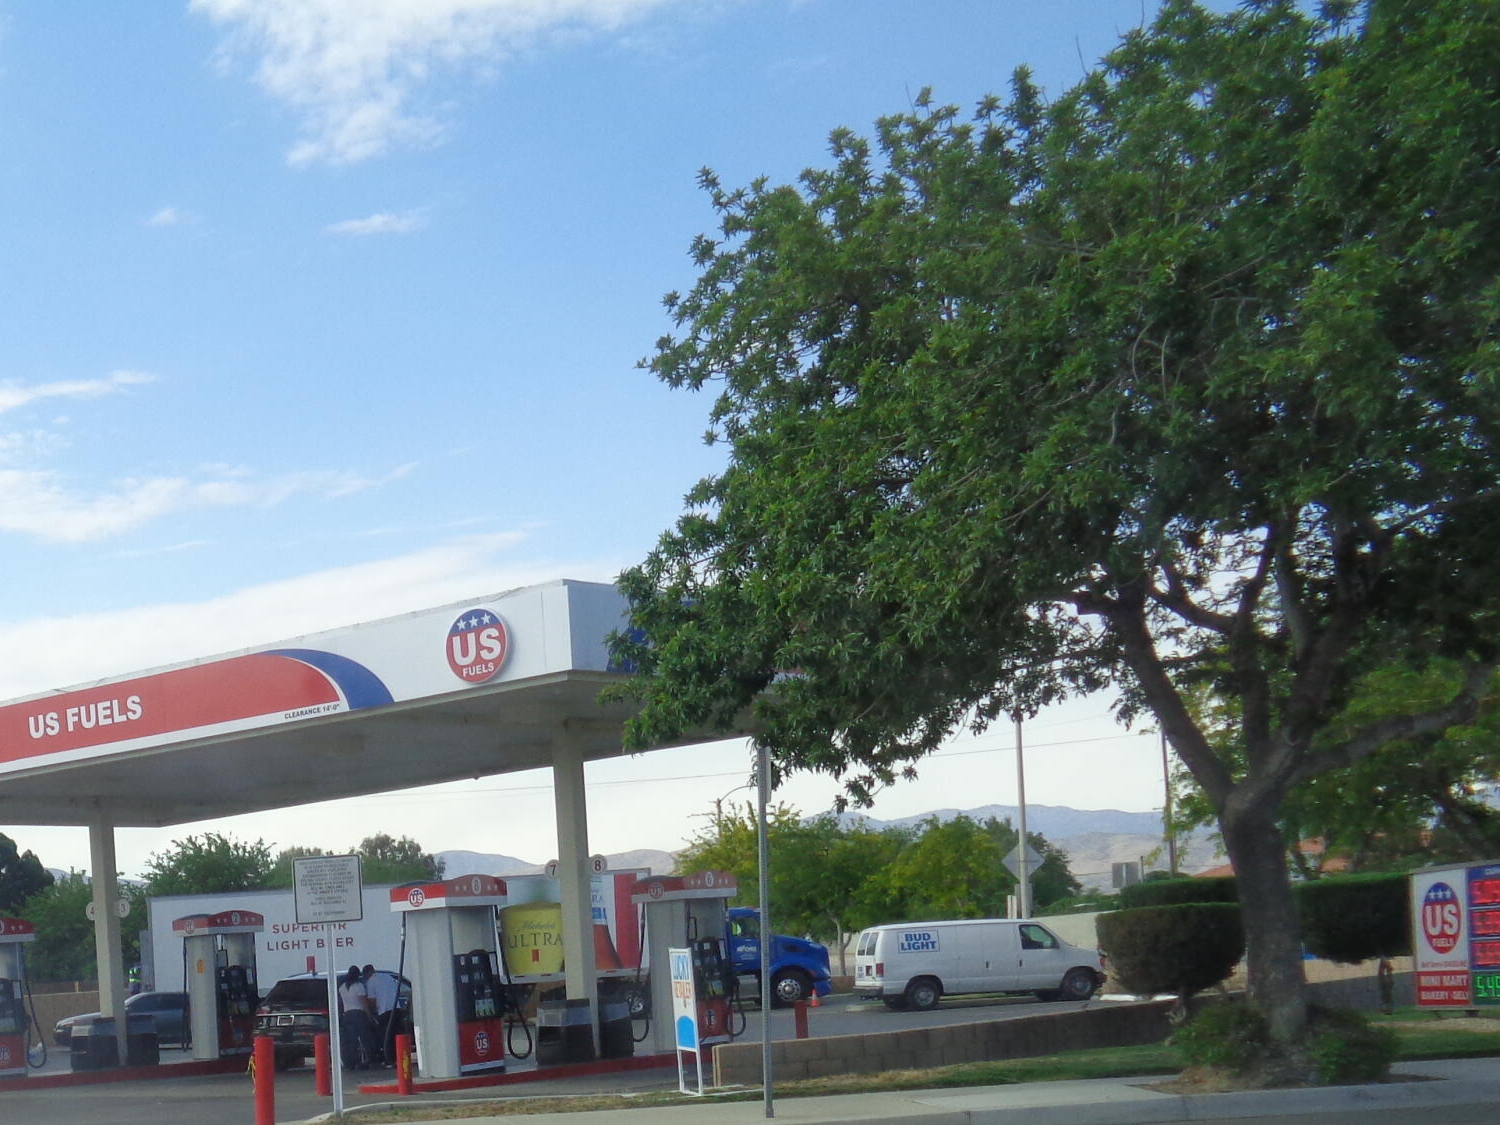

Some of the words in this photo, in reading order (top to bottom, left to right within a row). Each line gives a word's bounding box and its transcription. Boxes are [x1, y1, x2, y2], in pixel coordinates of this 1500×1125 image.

[452, 627, 502, 666] US
[462, 662, 495, 678] FUELS
[28, 711, 60, 739] US
[66, 695, 142, 732] FUELS
[284, 707, 321, 720] CLEARANCE
[550, 863, 557, 876] 7
[594, 859, 602, 872] 8
[410, 894, 423, 904] US
[1425, 903, 1459, 936] US
[272, 922, 347, 934] SUPERIR
[508, 932, 563, 949] ULTRA
[904, 932, 931, 942] BUD
[267, 939, 310, 951] LIGHT
[316, 937, 354, 949] BER
[900, 941, 937, 951] LIGHT
[476, 1038, 488, 1050] US
